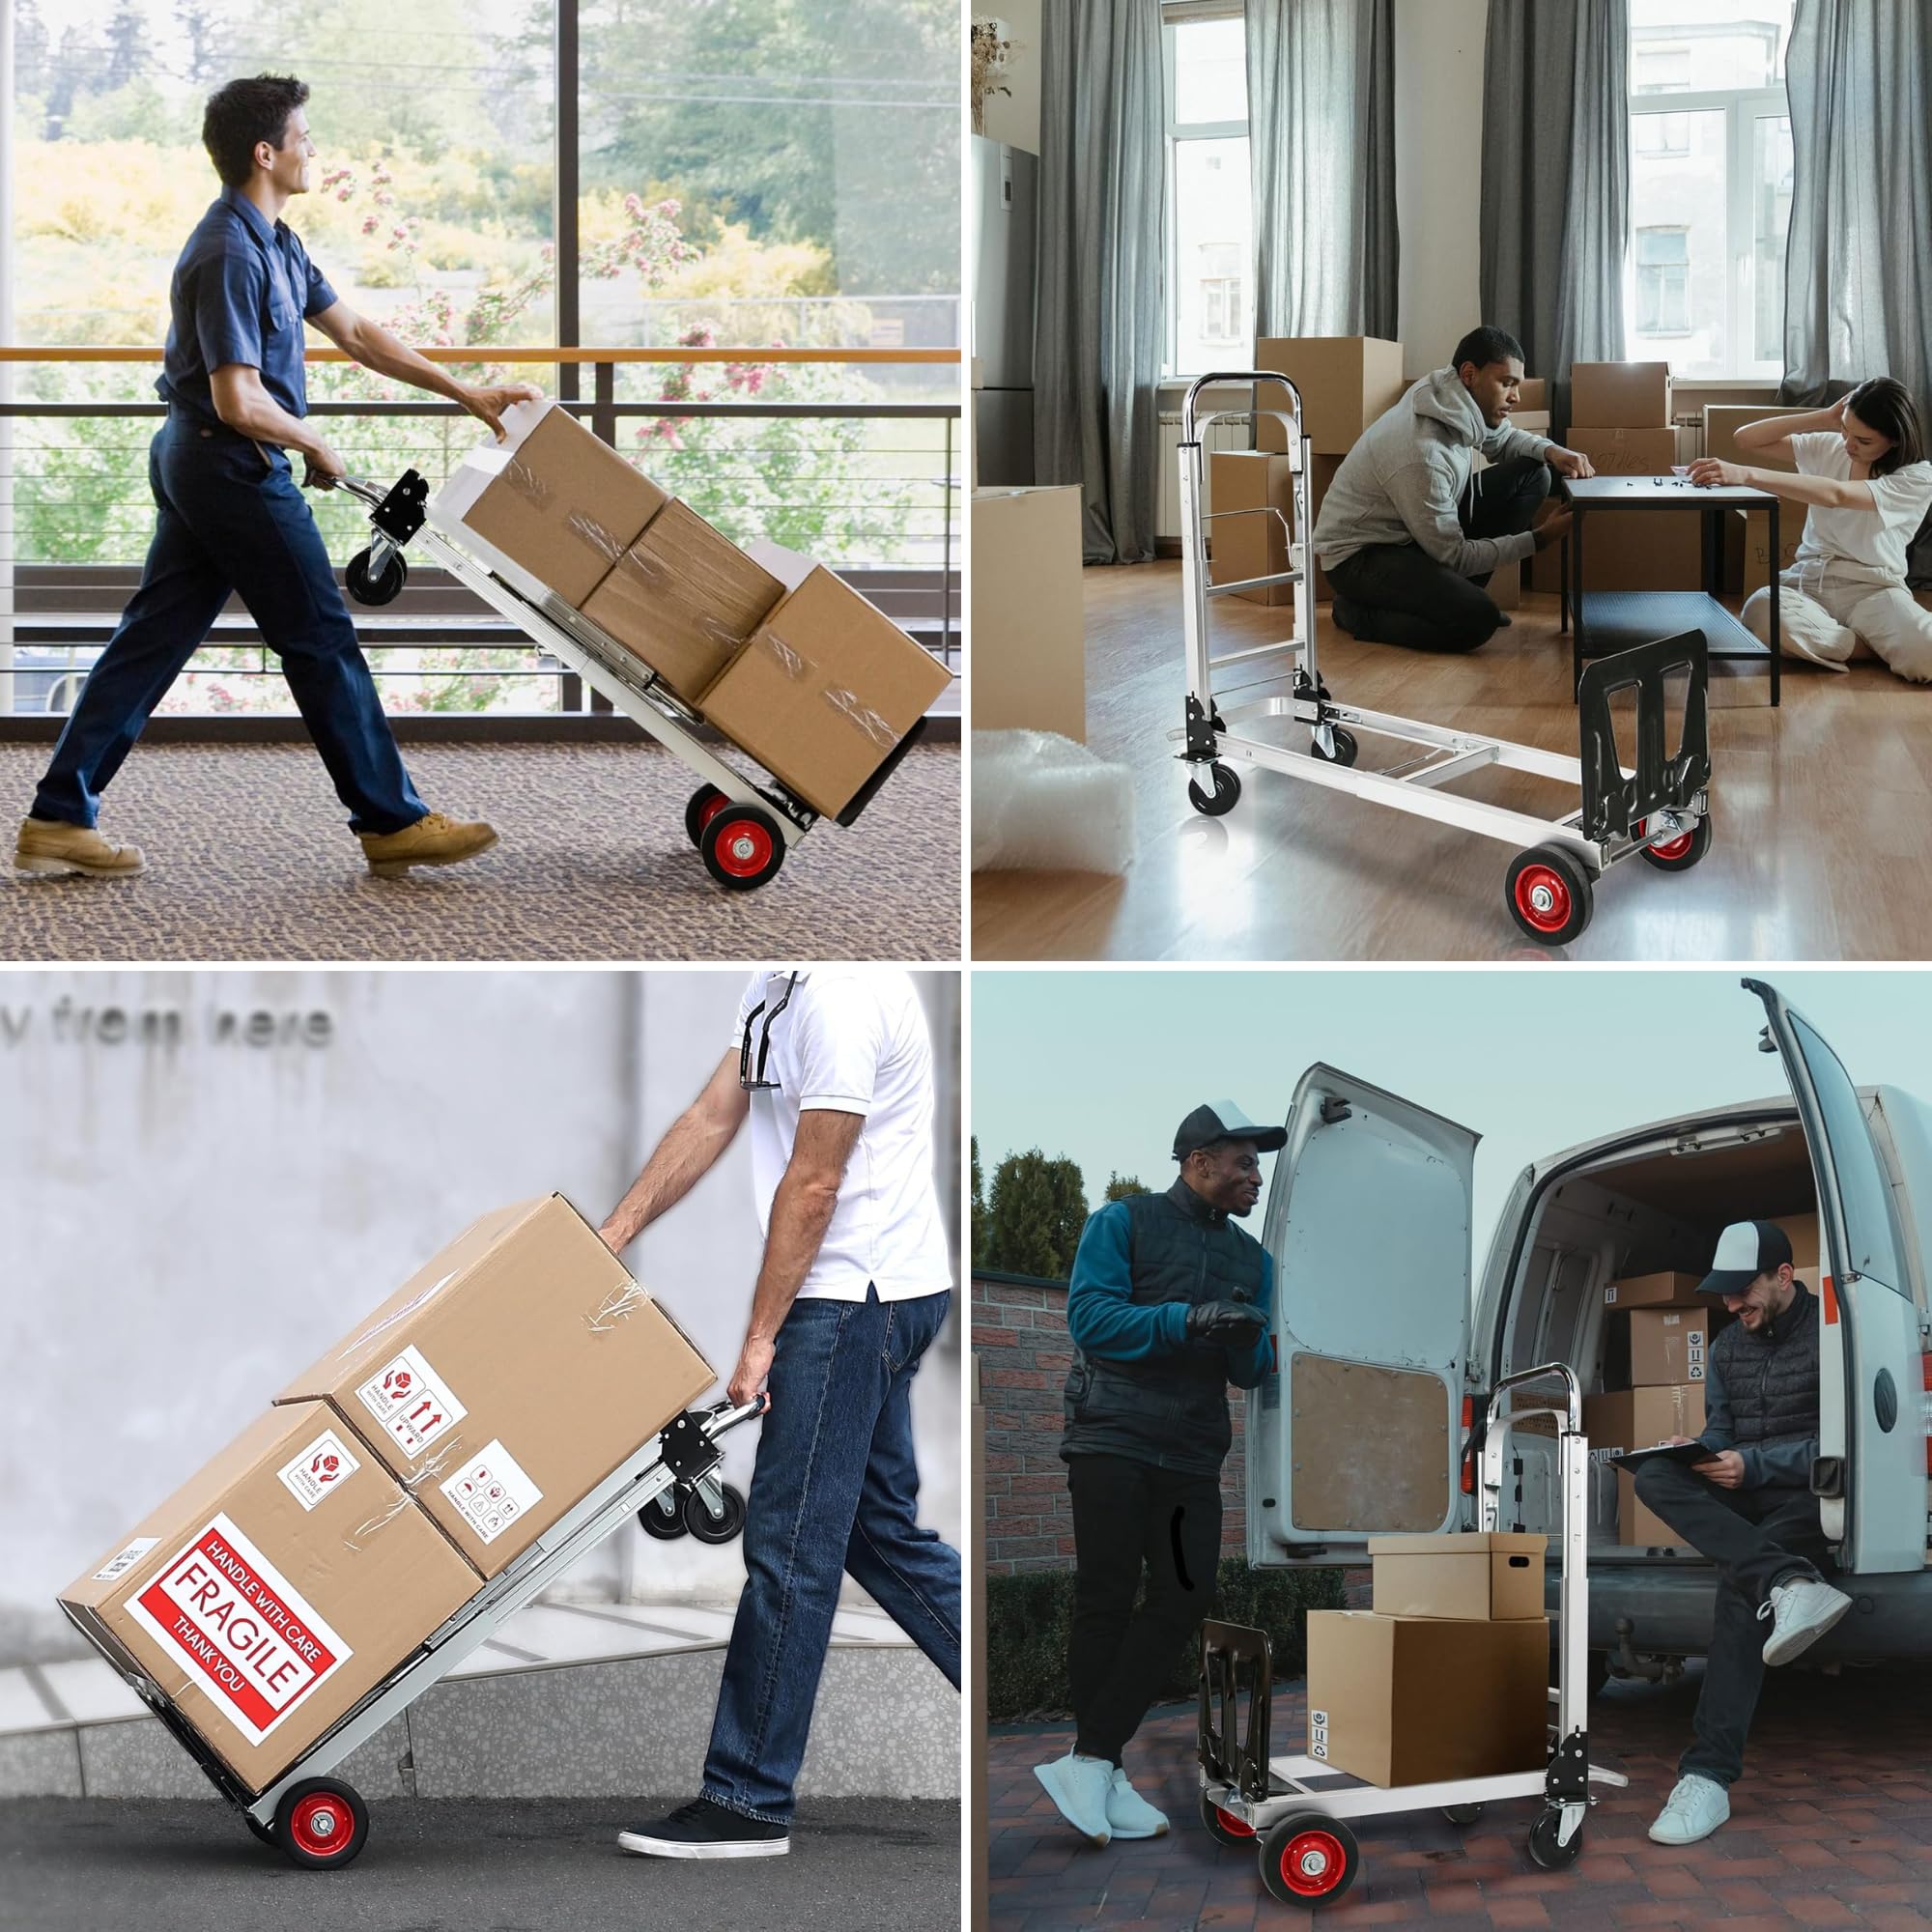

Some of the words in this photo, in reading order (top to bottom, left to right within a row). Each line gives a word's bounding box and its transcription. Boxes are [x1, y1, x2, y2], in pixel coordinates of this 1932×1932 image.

[367, 1391, 377, 1403] WITH
[376, 1402, 388, 1414] CARE
[371, 1385, 394, 1410] HANDLE
[399, 1415, 423, 1443] UPWARD
[295, 1475, 305, 1486] WITH
[304, 1486, 316, 1497] CARE
[299, 1469, 323, 1493] HANDLE
[448, 1491, 466, 1511] HANDLE
[465, 1511, 476, 1524] WITH
[476, 1524, 489, 1538] CARE
[206, 1540, 259, 1595] HANDLE
[255, 1590, 288, 1629] WITH
[285, 1625, 322, 1663] CARE
[175, 1562, 299, 1693] FRAGILE
[173, 1617, 218, 1663] THANK
[213, 1657, 245, 1692] YOU
